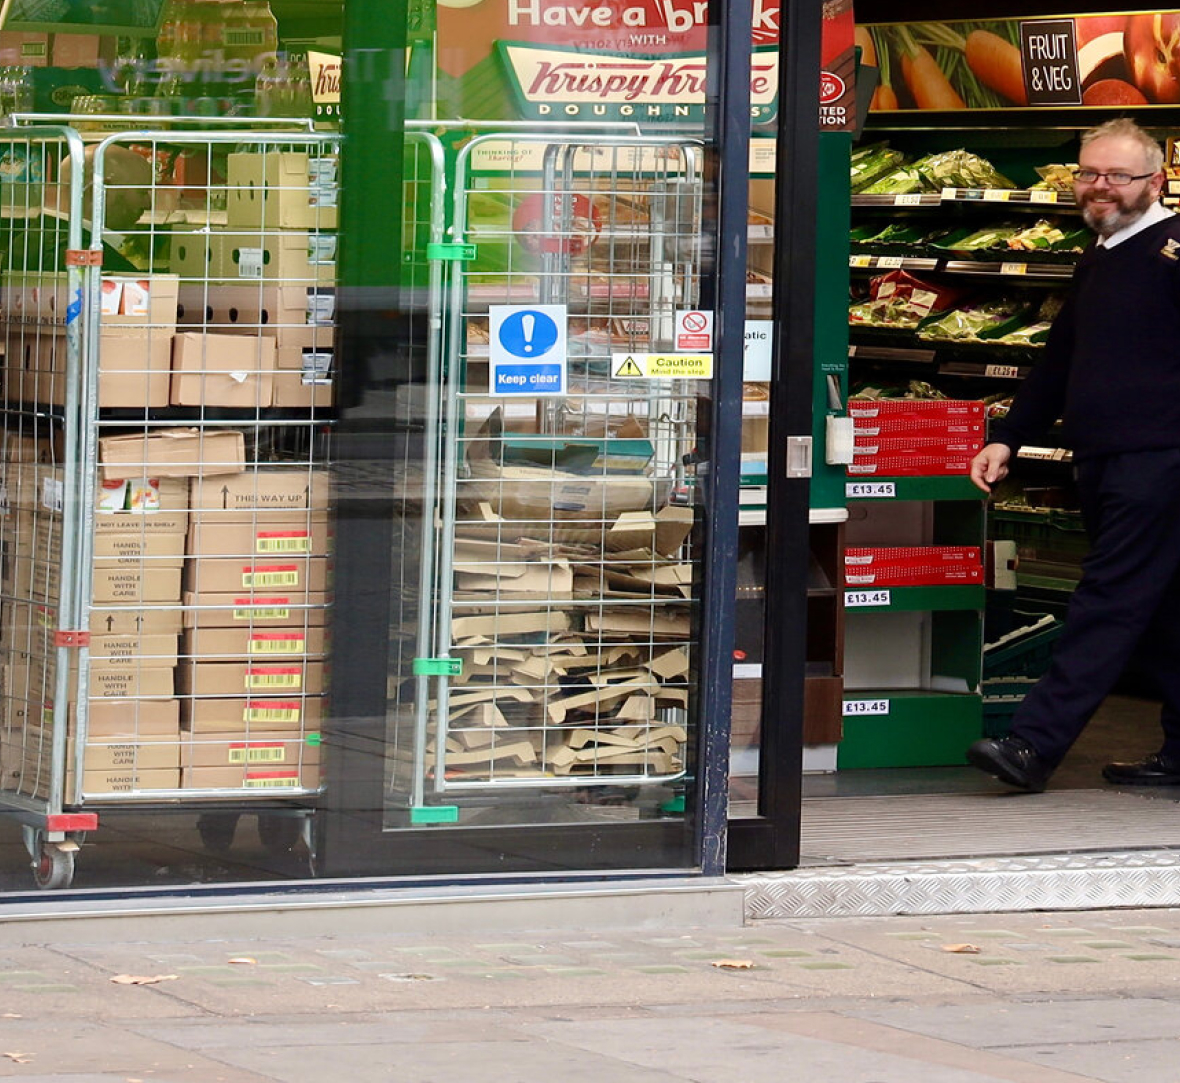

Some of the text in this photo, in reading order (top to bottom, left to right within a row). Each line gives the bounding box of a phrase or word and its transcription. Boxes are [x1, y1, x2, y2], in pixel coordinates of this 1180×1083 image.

[621, 6, 647, 27] a
[630, 33, 667, 45] WITH
[1028, 33, 1069, 60] FRUIT
[527, 61, 655, 100] Krispy
[1031, 64, 1072, 91] & VEG
[539, 103, 761, 117] DOUGHNS
[656, 357, 703, 367] Caution
[687, 368, 705, 377] step
[498, 373, 559, 386] Keep clear
[852, 484, 893, 494] £13.45
[847, 592, 887, 602] £13.45
[846, 701, 886, 711] £13.45
